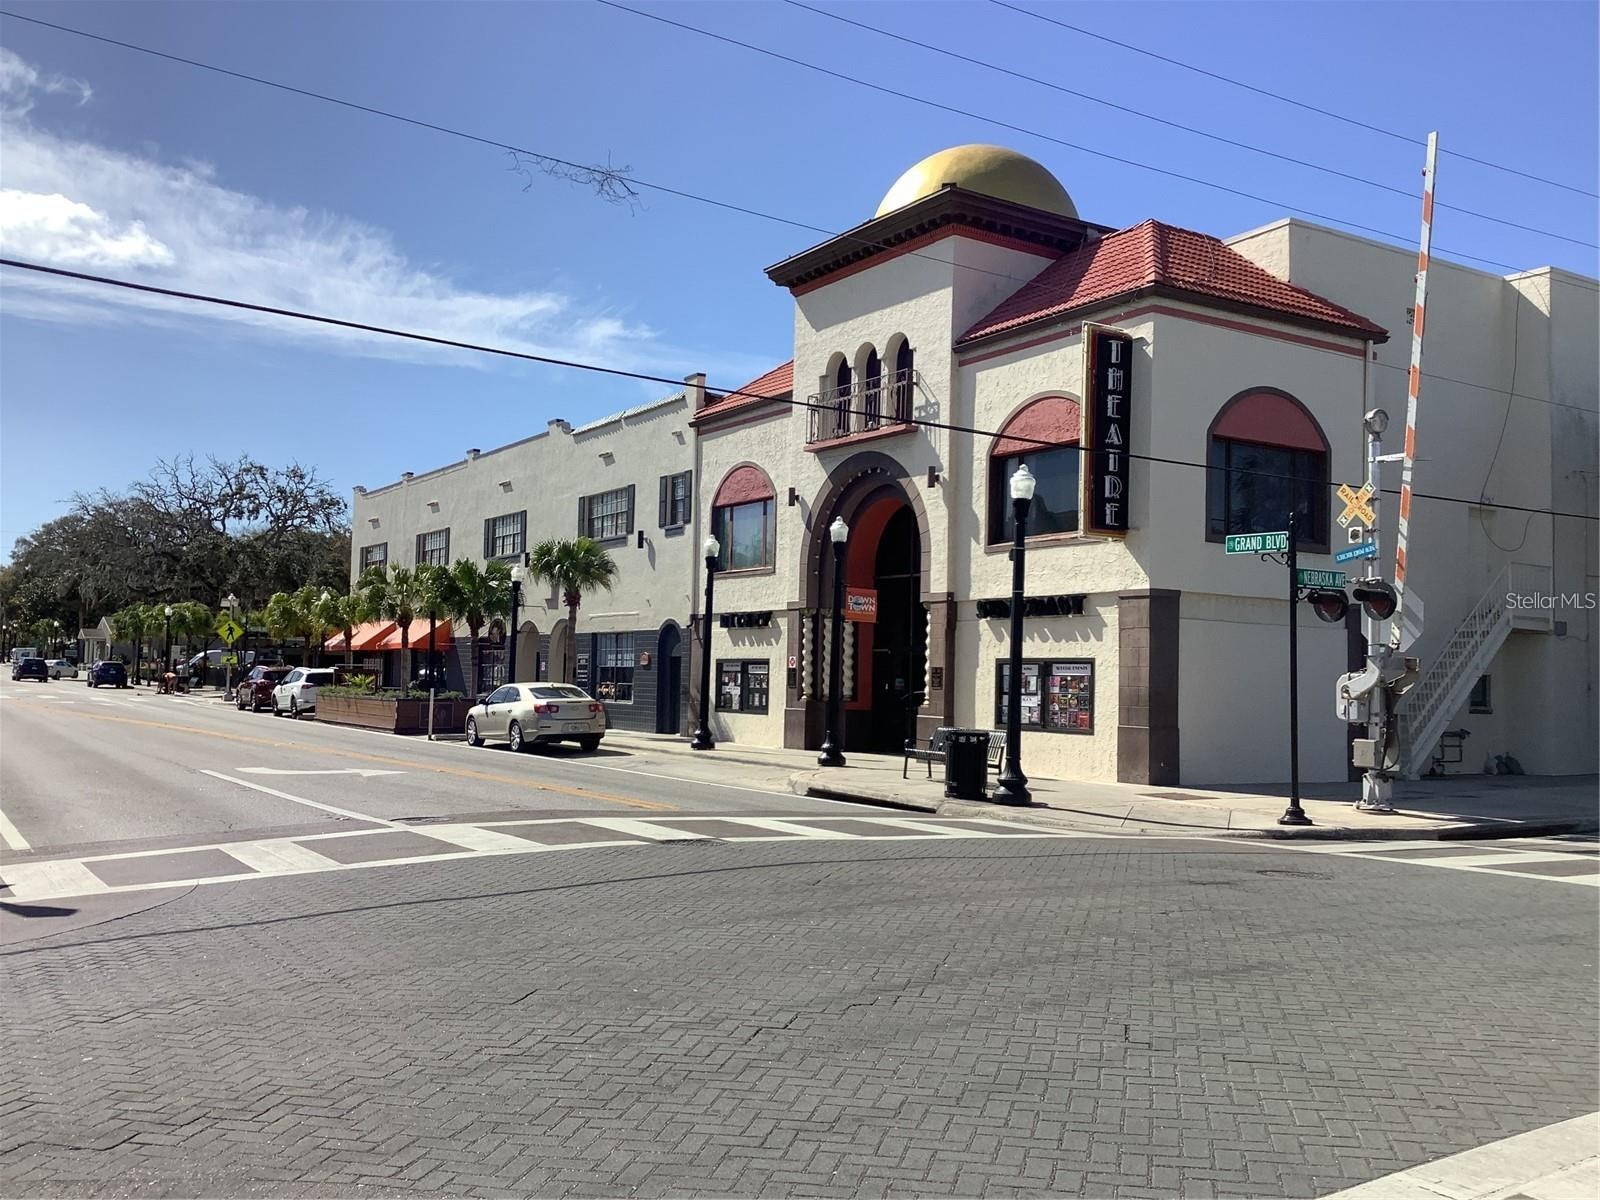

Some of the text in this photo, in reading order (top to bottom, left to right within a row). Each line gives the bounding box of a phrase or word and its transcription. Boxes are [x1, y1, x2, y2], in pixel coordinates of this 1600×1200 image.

[1104, 340, 1124, 526] THEATRE
[1235, 535, 1286, 551] GRAND BLVD
[1304, 571, 1345, 587] NEBRASKA AVE
[848, 595, 876, 604] DOWN
[848, 602, 876, 612] TOWN
